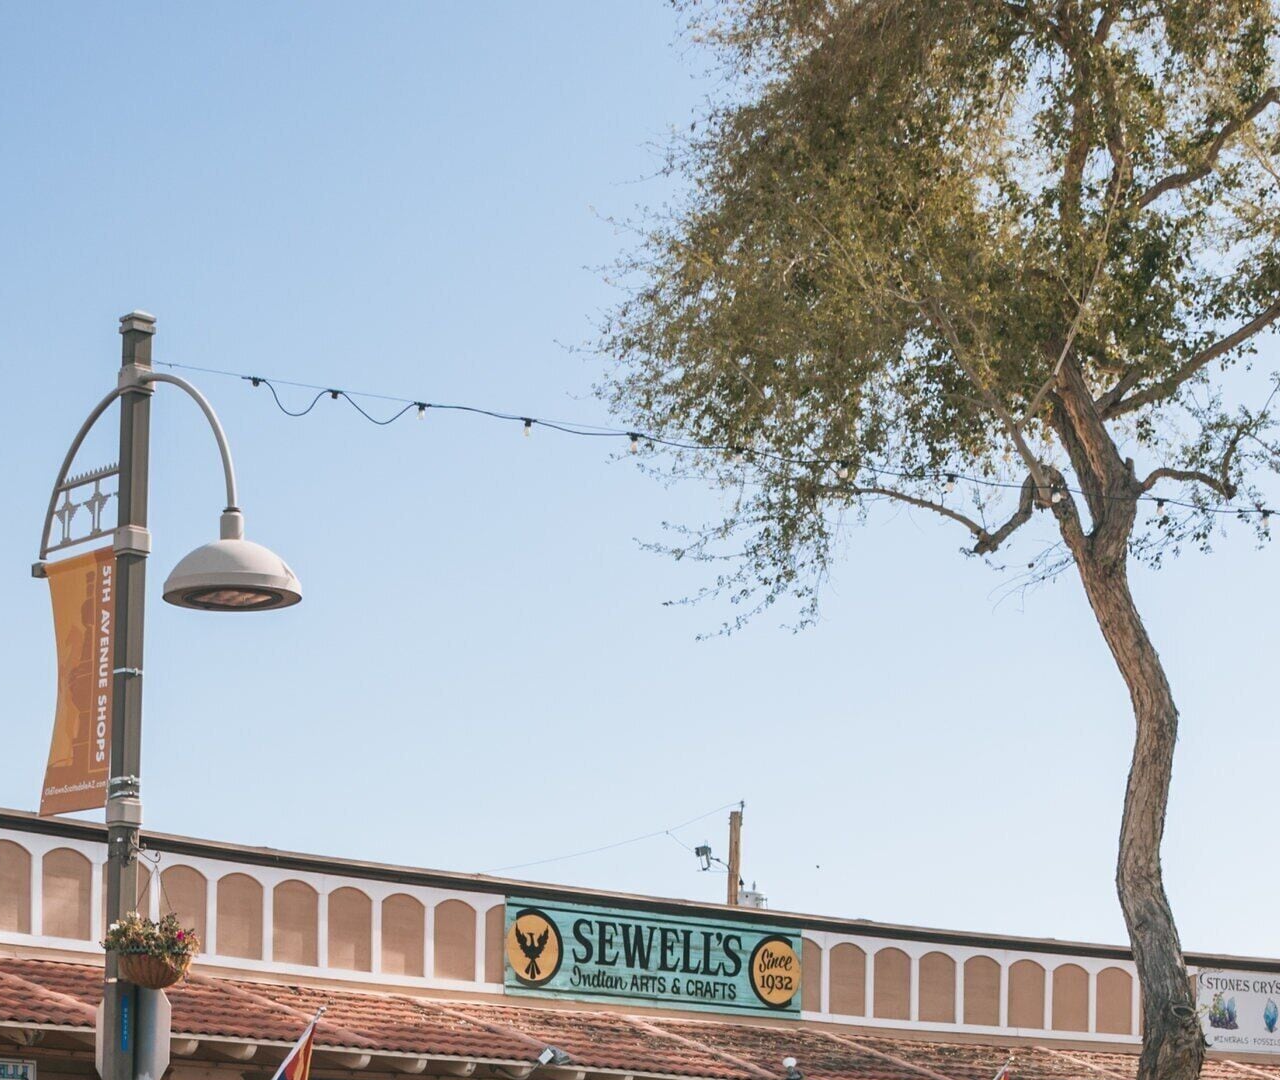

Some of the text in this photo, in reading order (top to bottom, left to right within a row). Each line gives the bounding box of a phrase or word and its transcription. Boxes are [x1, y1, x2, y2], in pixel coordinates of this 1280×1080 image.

[95, 565, 112, 763] 5TH AVENUE SHOPS
[571, 917, 742, 978] SEWELL'S
[758, 947, 793, 974] Since
[569, 964, 738, 1001] Indian ARTS & CRAFTS
[759, 973, 794, 995] 1932
[1206, 976, 1251, 993] STONES
[1213, 1035, 1250, 1045] MINERALS
